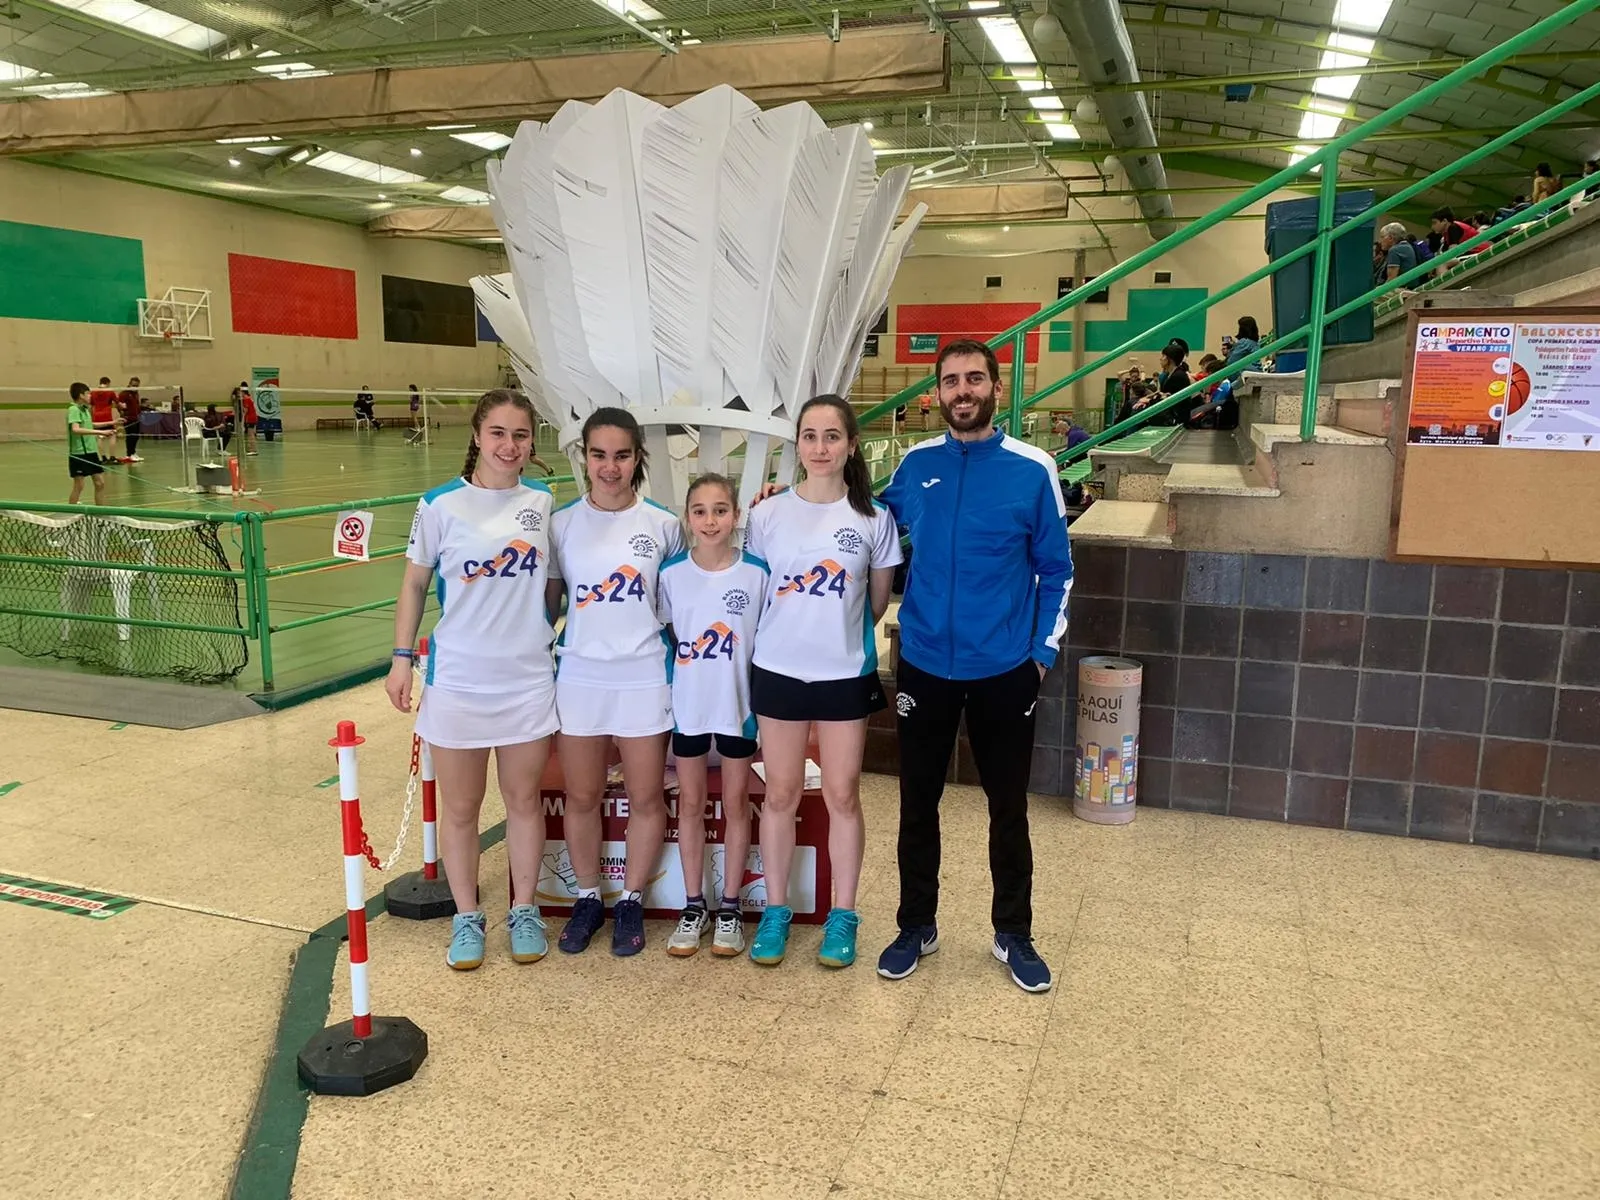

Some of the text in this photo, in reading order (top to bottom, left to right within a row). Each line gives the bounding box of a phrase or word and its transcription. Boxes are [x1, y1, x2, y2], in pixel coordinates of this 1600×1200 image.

[1421, 327, 1510, 337] CAMPAMENTO
[1521, 328, 1600, 336] BALONCEST
[1088, 694, 1123, 710] AQUÍ
[1081, 707, 1118, 724] PILAS
[12, 888, 103, 910] DEPORTISTAS
